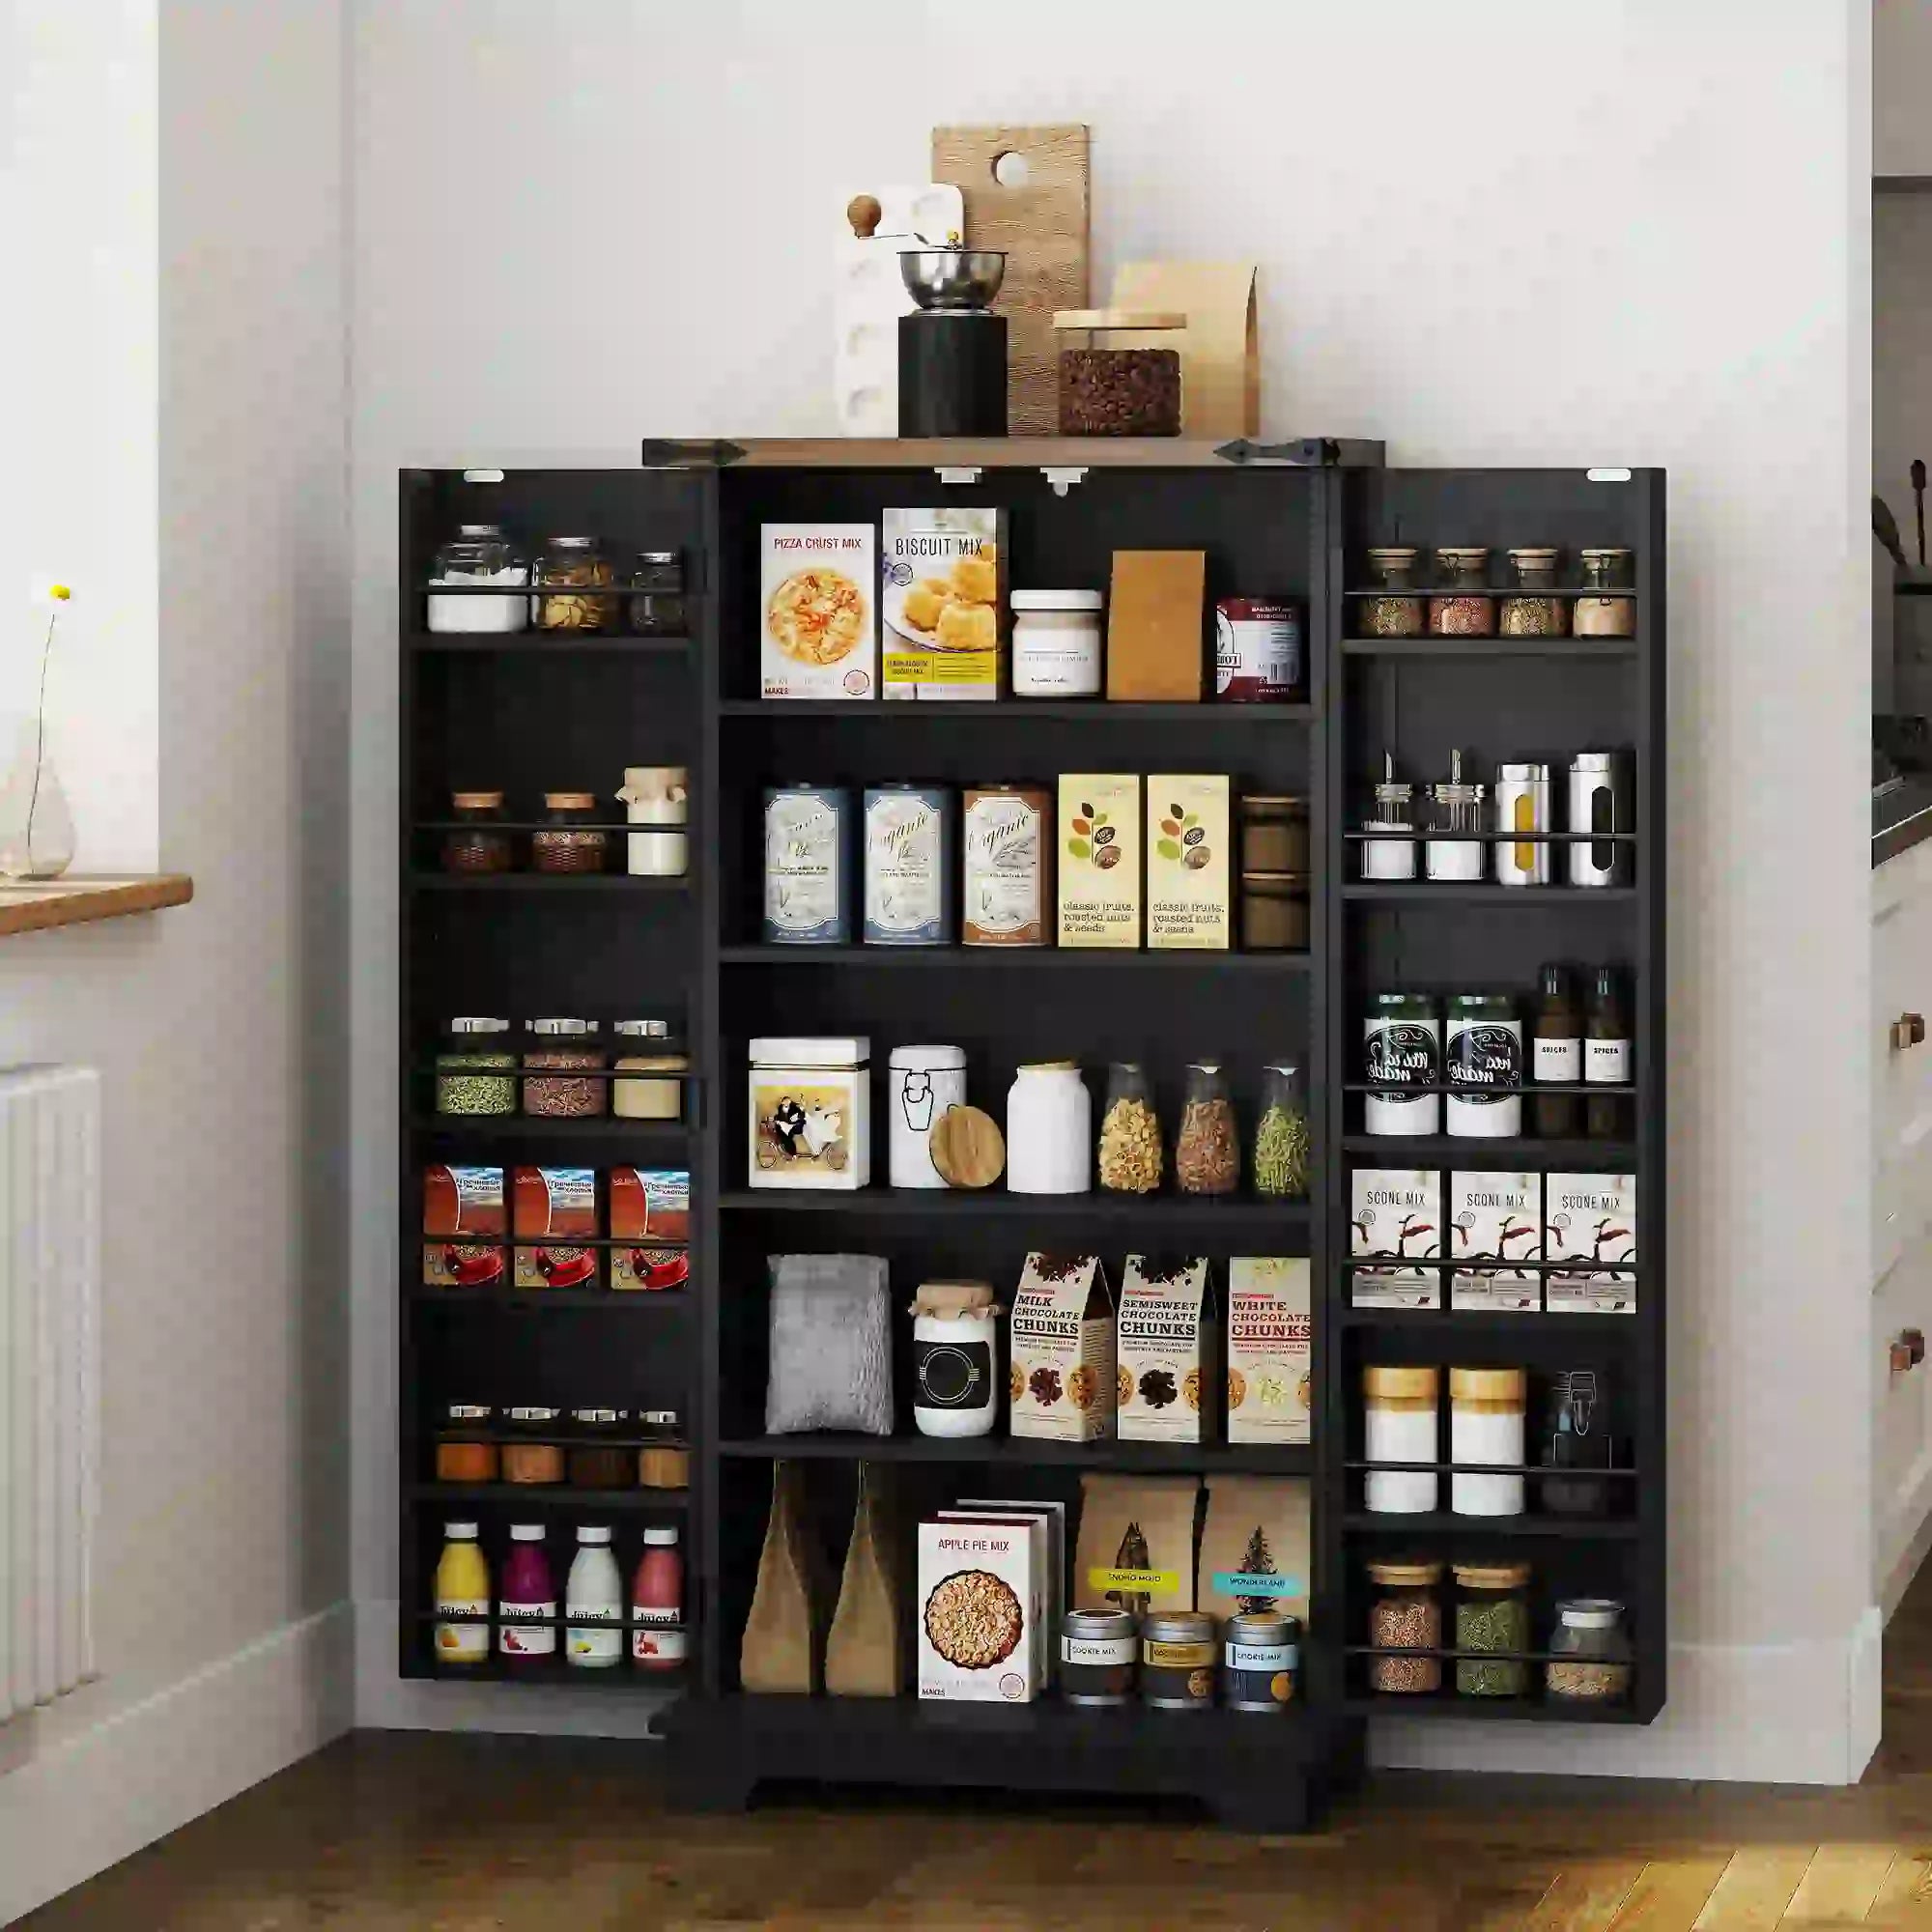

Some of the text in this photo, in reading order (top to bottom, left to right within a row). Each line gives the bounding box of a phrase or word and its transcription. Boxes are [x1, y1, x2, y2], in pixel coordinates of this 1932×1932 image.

[774, 538, 862, 549] PIZZA CRUST MIX
[895, 538, 982, 555] BISCUIT MIX
[1367, 1191, 1426, 1206] SCONE MIX
[1466, 1193, 1525, 1207] SCONE MIX
[1562, 1195, 1620, 1208] SCONE MIX
[1017, 1295, 1053, 1307] MILK
[1122, 1299, 1198, 1311] SEMISWEET
[1233, 1301, 1287, 1311] WHITE
[1014, 1307, 1080, 1320] CHOCOLATE
[1122, 1310, 1197, 1321] CHOCOLATE
[1233, 1314, 1310, 1322] CHOCOLATE
[1013, 1319, 1079, 1334] CHUNKS
[1121, 1321, 1196, 1336] CHUNKS
[1233, 1324, 1310, 1337] CHUNKS
[938, 1538, 1009, 1551] APPLE PIE MIX
